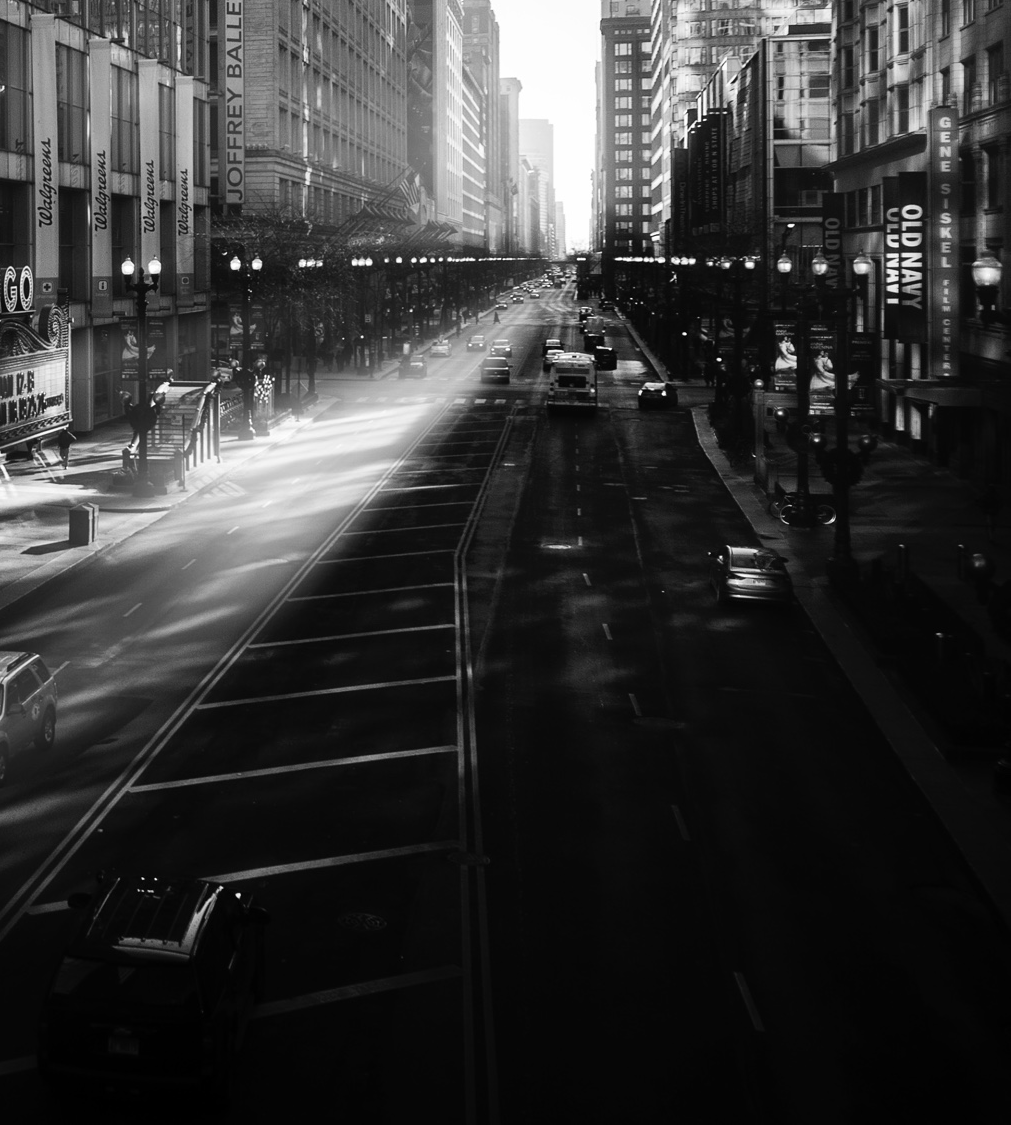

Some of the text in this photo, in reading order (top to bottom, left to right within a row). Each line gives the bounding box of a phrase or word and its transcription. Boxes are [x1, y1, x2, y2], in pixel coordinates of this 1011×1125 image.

[37, 137, 57, 228] Walgreens
[227, 87, 243, 201] JOFFREY
[93, 150, 110, 231] Walgreens
[143, 159, 159, 233] Walgreens
[178, 168, 192, 236] Walgreens
[824, 218, 840, 287] OLD NAV
[901, 204, 923, 310] OLD NAVY
[939, 116, 952, 370] GENE SISKEL FILM CENTER
